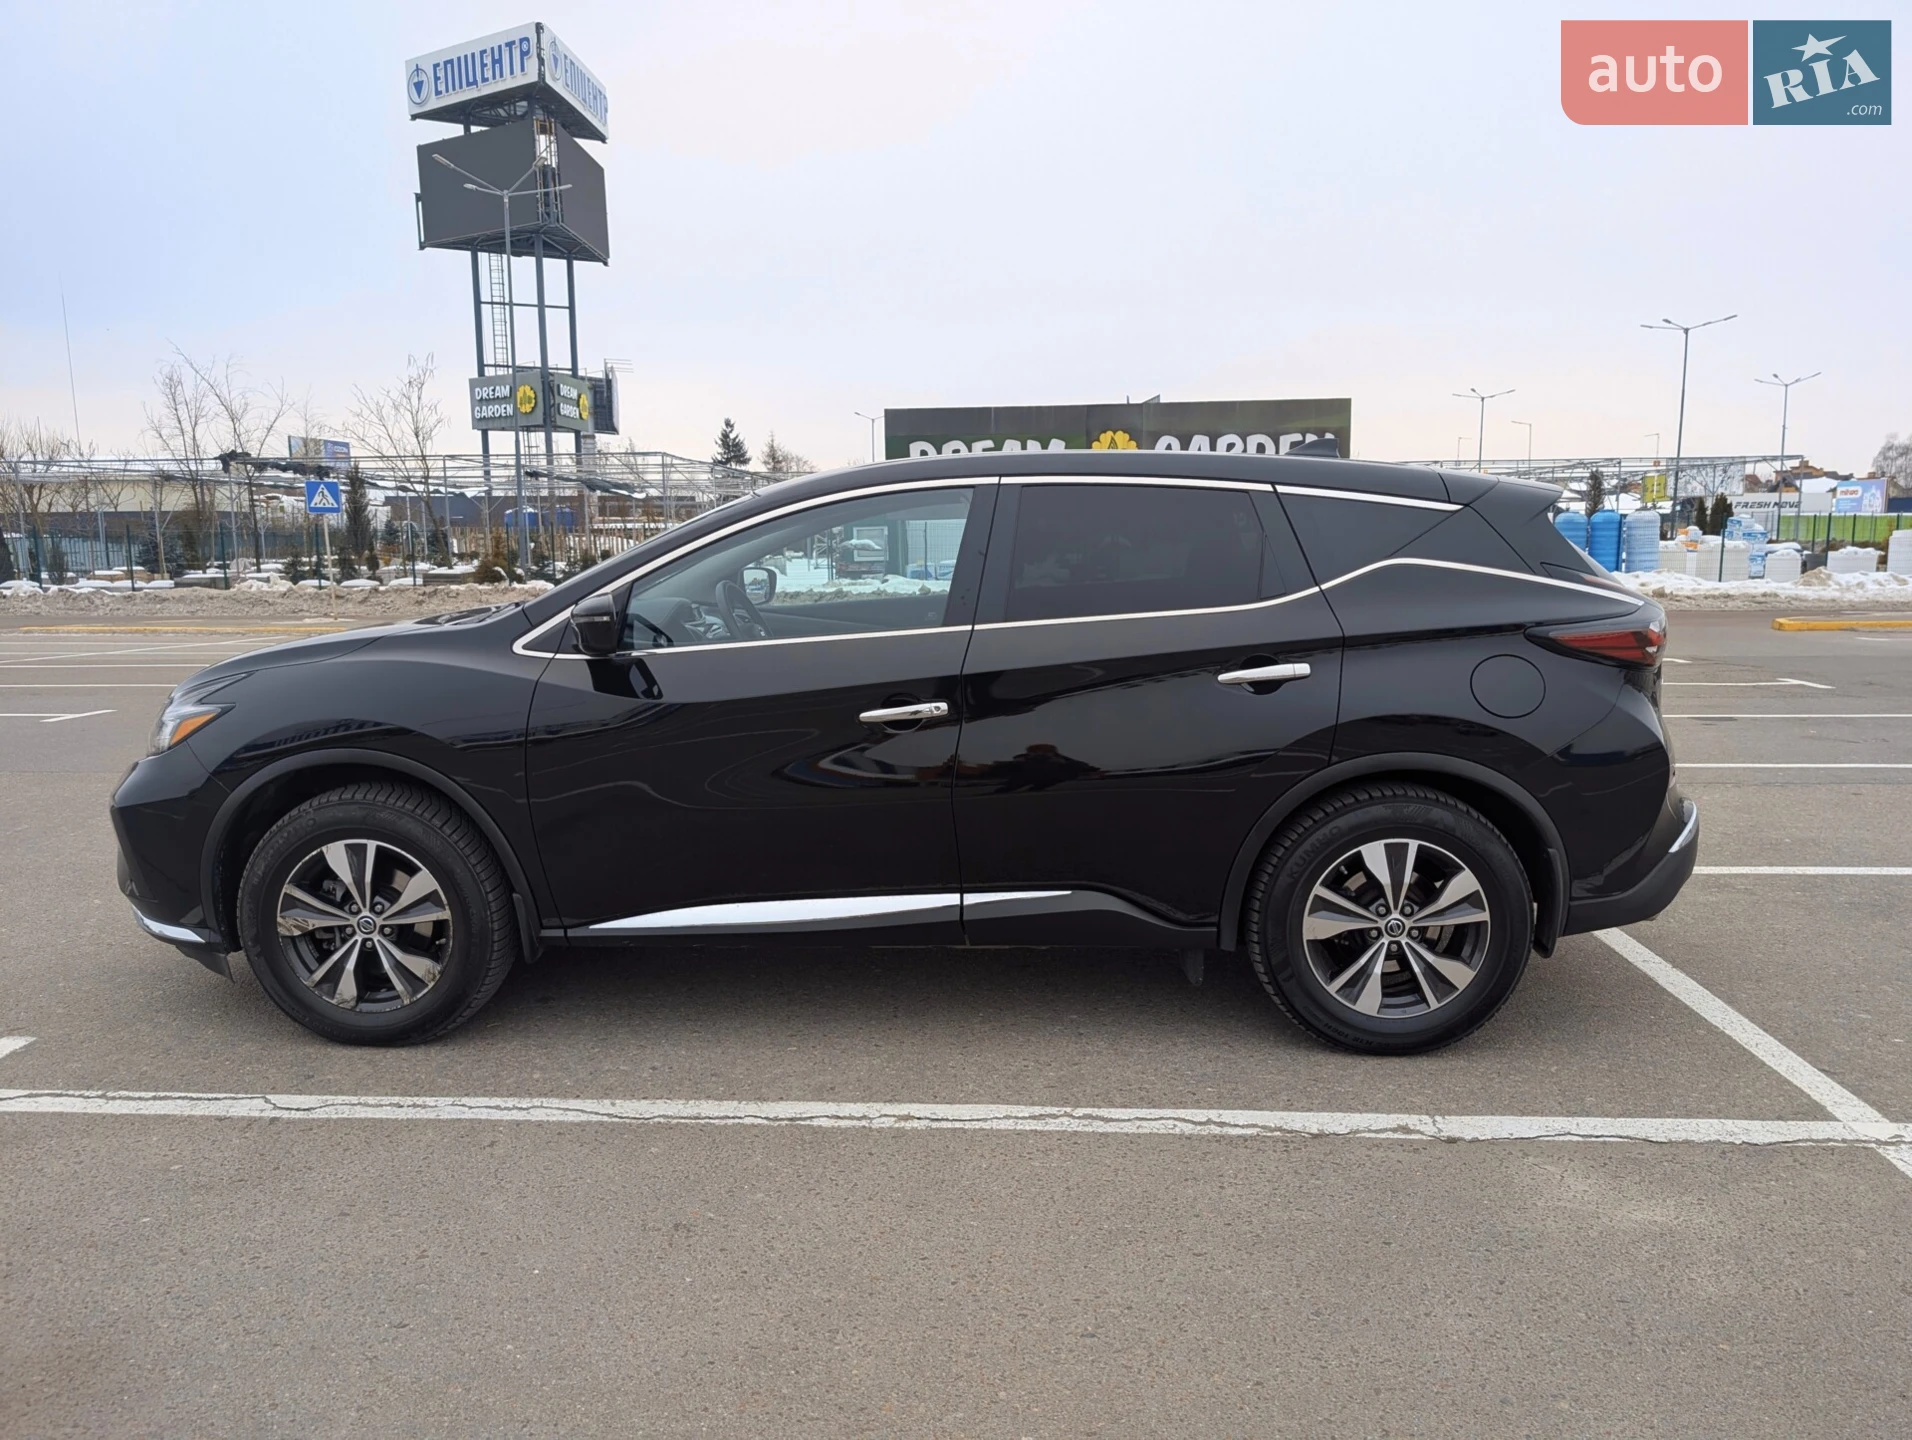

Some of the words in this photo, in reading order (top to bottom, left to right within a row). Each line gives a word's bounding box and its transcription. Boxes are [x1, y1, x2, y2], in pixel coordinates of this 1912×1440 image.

[432, 36, 532, 98] ЕПІЦЕНТР
[474, 384, 511, 400] DREAM
[559, 383, 578, 400] DREAM
[474, 403, 514, 419] GARDEN
[559, 402, 580, 420] GARDEN
[1734, 501, 1771, 509] FRESH
